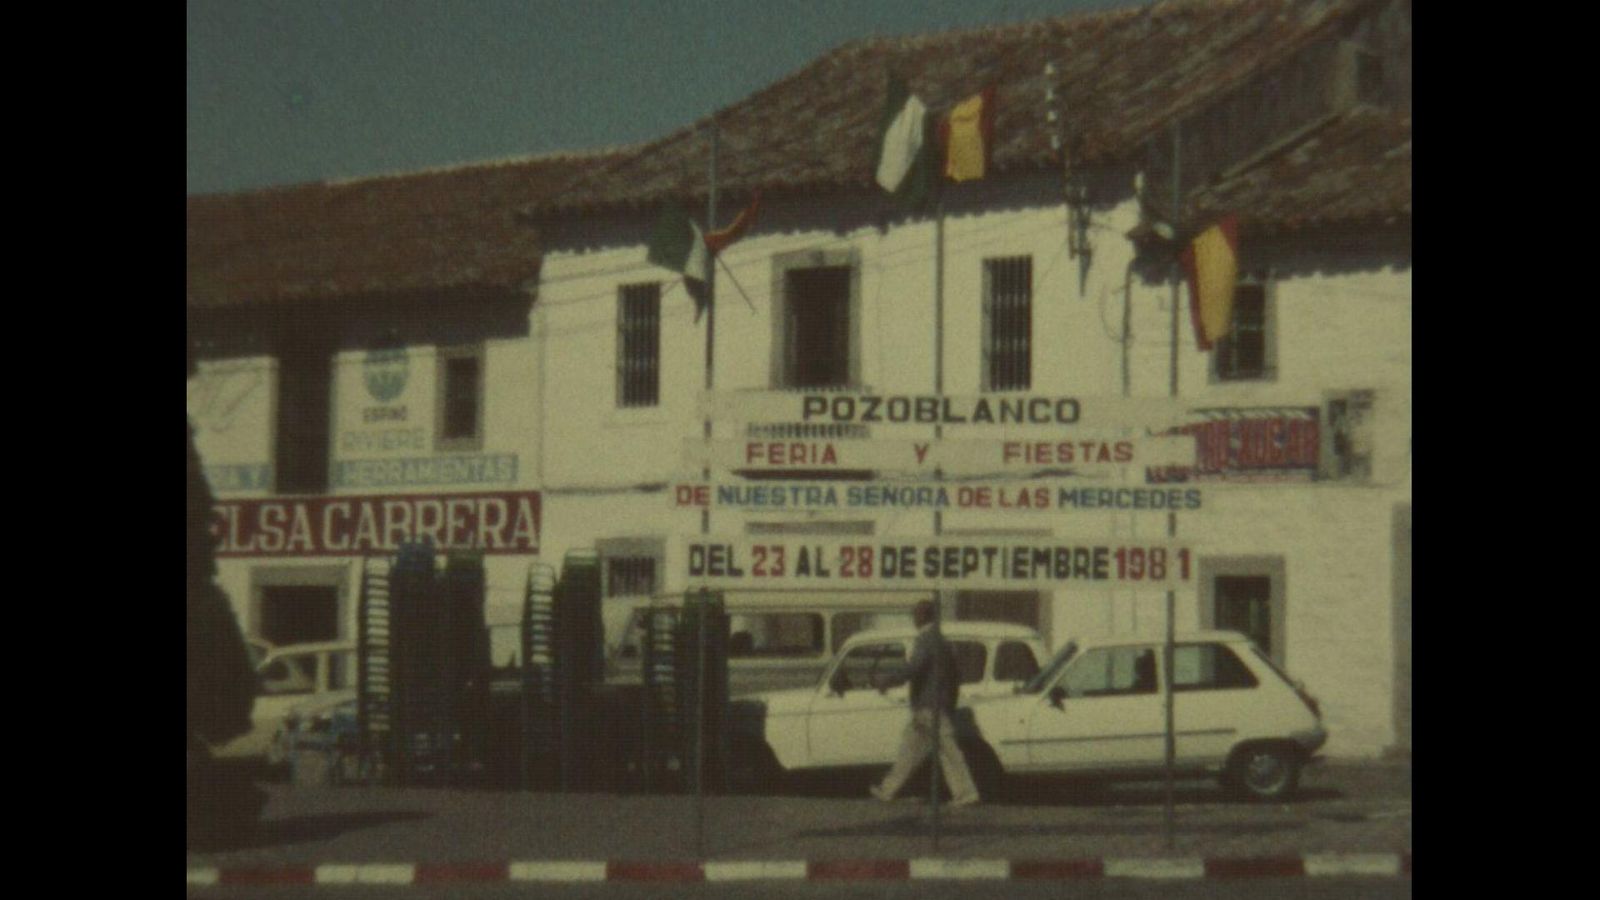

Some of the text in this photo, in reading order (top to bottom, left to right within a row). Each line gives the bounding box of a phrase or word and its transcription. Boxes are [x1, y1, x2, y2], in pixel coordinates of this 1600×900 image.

[802, 396, 1081, 425] POZOBLANCO
[342, 429, 427, 451] RIVIERE
[745, 441, 1134, 465] FERIA Y FIESTAS
[343, 455, 514, 484] HERRAMIENTAS
[675, 484, 711, 507] DE
[716, 485, 839, 507] NUESTRA
[956, 486, 993, 509] DE
[999, 486, 1051, 509] LAS
[1057, 487, 1203, 510] MERCEDES
[321, 496, 539, 553] CABRERA
[688, 544, 1191, 582] DEL 23 AL 28 DE SEPTIEMBRE 1981
